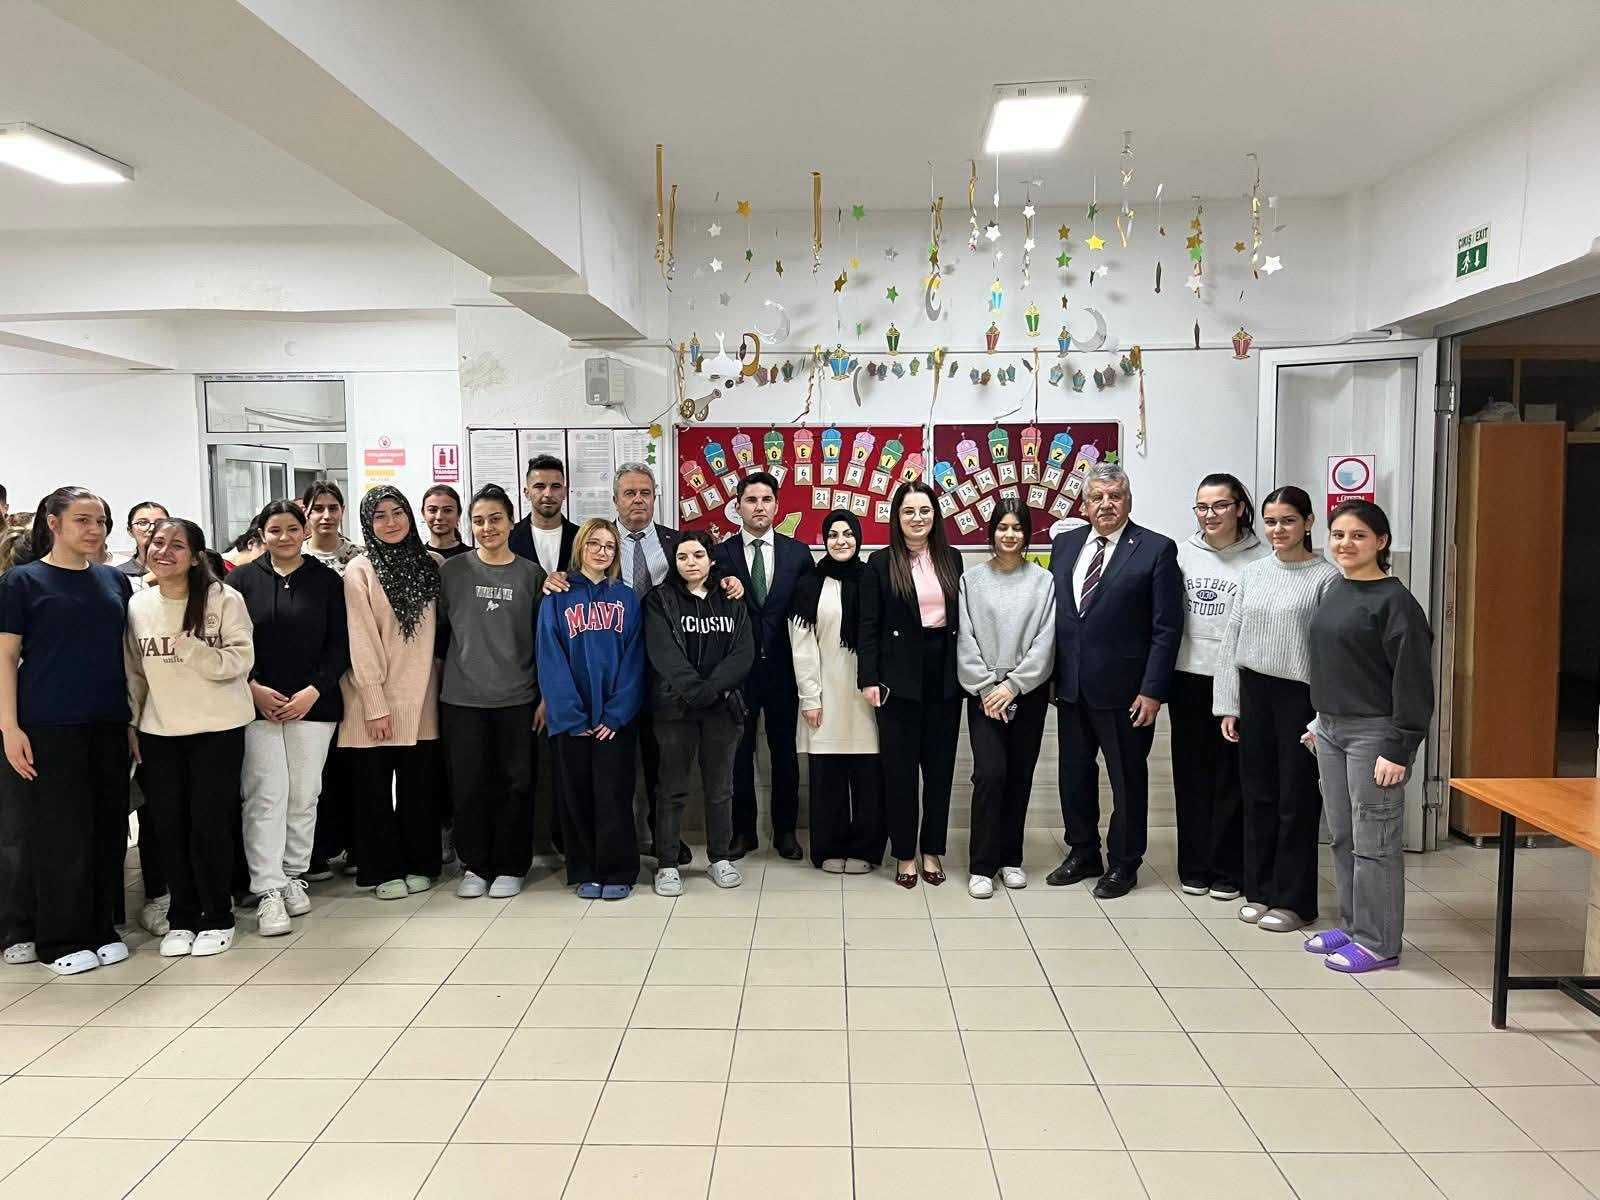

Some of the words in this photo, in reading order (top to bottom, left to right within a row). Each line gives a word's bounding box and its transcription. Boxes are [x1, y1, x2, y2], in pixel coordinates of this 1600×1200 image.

[1475, 226, 1489, 242] EXIT
[801, 469, 807, 477] 6
[1002, 467, 1012, 475] 15
[1026, 467, 1036, 475] 16
[1047, 471, 1058, 480] 17
[980, 476, 990, 484] 14
[1069, 480, 1080, 489] 18
[962, 487, 972, 496] 13
[1032, 491, 1043, 499] 29
[816, 492, 826, 501] 21
[836, 495, 846, 503] 22
[855, 498, 866, 507] 23
[941, 499, 951, 508] 12
[982, 502, 991, 512] 27
[1057, 501, 1067, 510] 30
[879, 506, 889, 514] 24
[960, 517, 971, 525] 26
[1187, 599, 1226, 616] STUDIO
